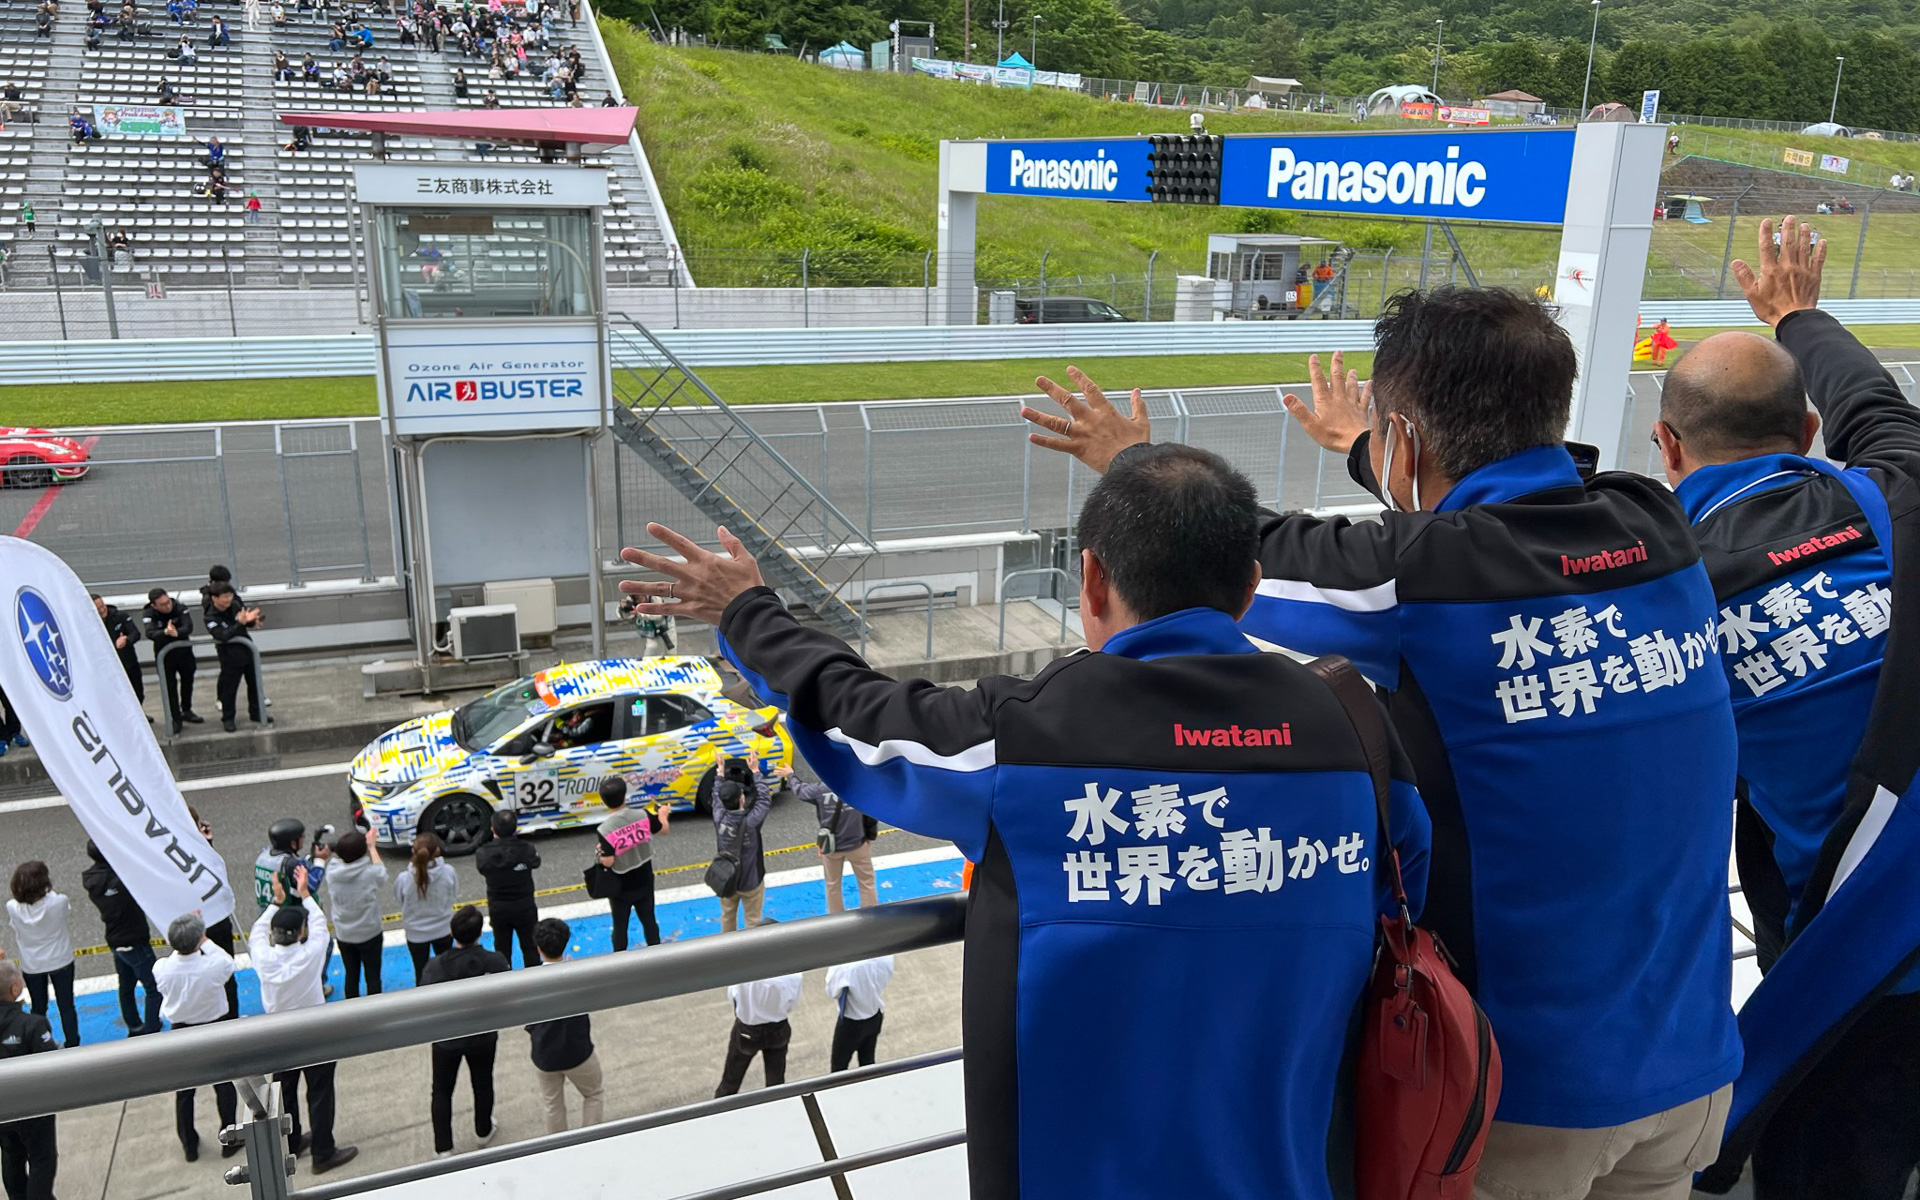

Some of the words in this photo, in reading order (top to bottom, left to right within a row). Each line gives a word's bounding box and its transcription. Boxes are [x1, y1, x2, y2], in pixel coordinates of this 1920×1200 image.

[417, 177, 554, 195] 三友商事株式会社
[1010, 148, 1118, 192] Panasonic
[1267, 145, 1487, 207] Panasonic
[408, 363, 461, 372] Ozone
[469, 362, 494, 371] Air
[502, 360, 584, 370] Generator
[407, 382, 452, 402] AIR
[480, 378, 583, 400] BUSTER
[1560, 540, 1648, 576] Iwatani
[1767, 525, 1863, 566] Iwatani
[1717, 570, 1839, 654] 水素で
[1490, 603, 1628, 671] 水素で
[1173, 723, 1292, 746] Iwatani
[519, 779, 555, 807] 32
[615, 823, 642, 837] MEDIA
[1063, 782, 1230, 846] 水素で
[617, 829, 646, 850] 210
[1062, 827, 1370, 906] 世界を動かせ。
